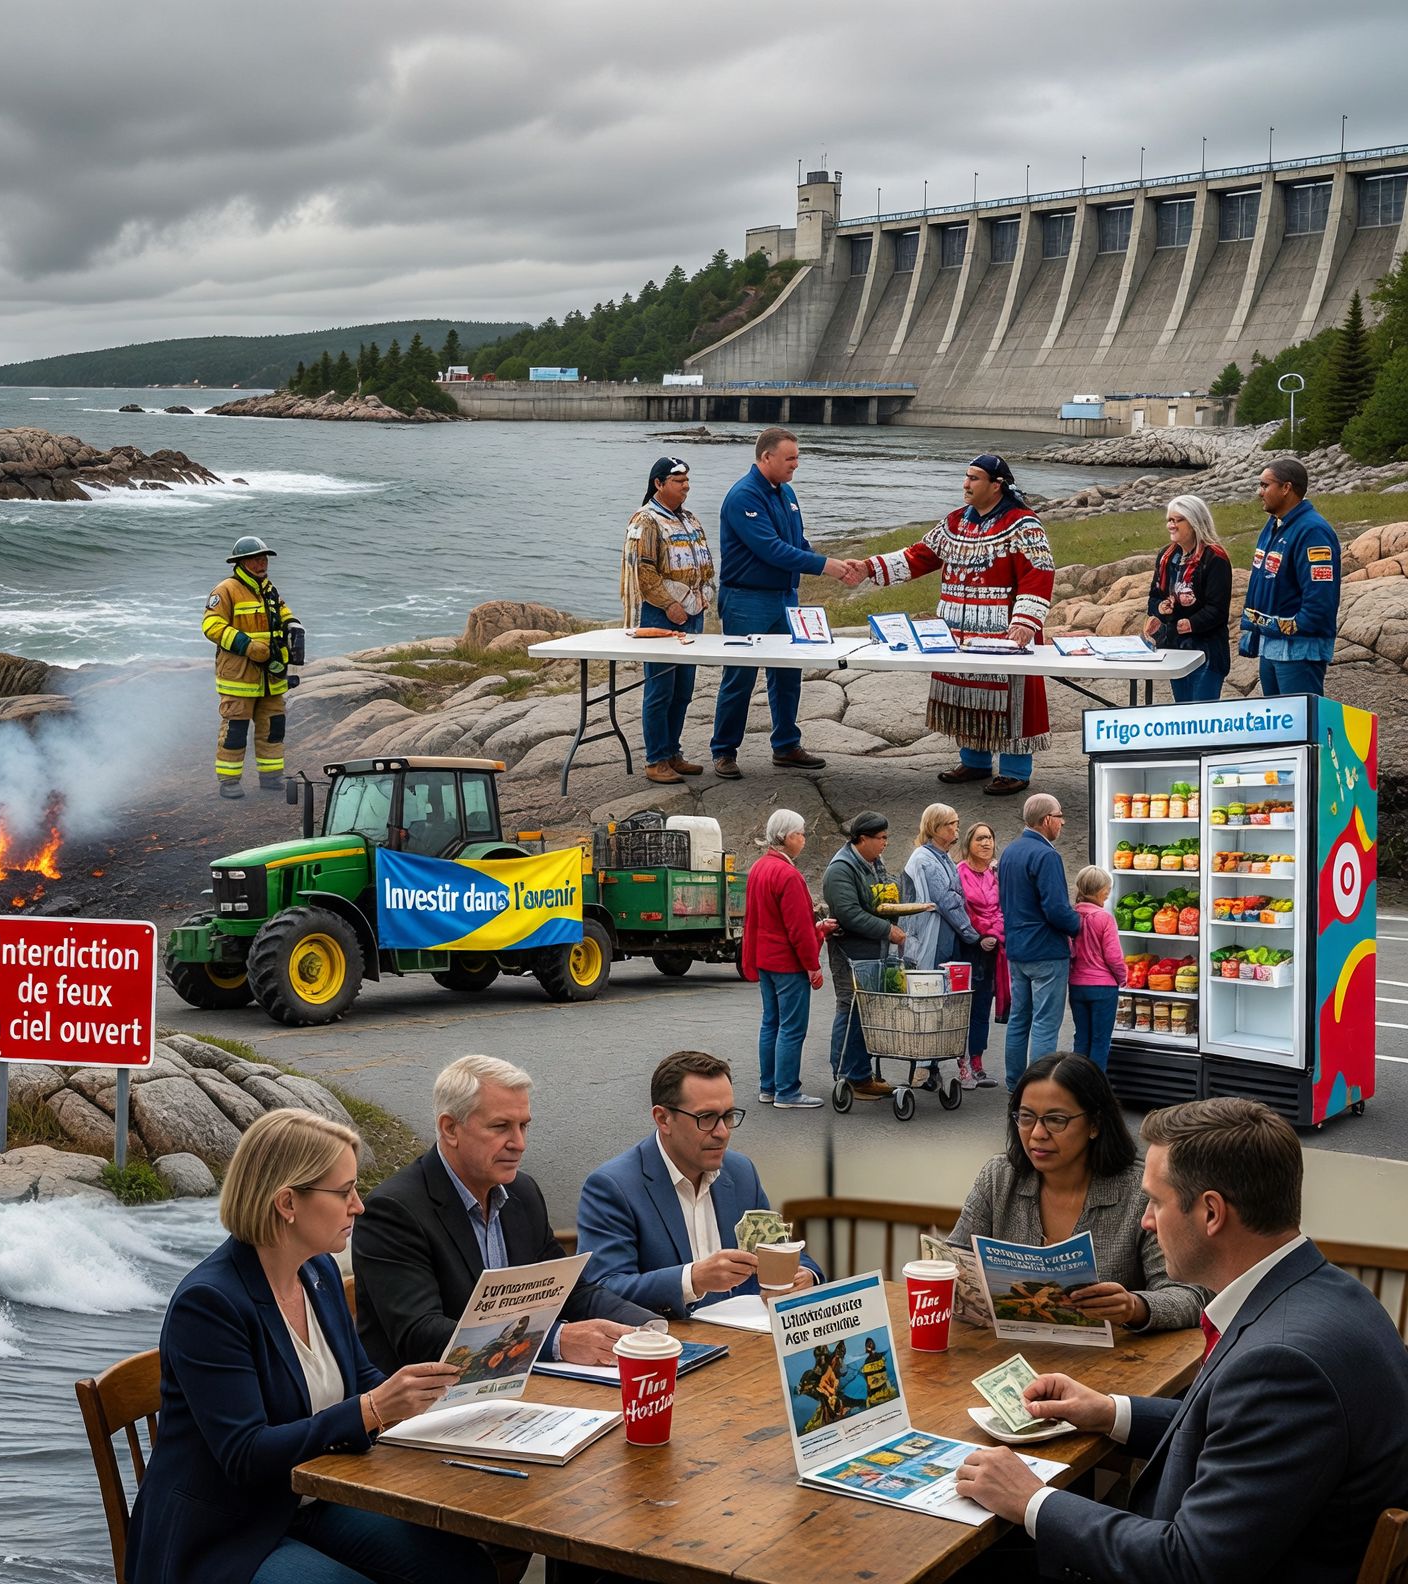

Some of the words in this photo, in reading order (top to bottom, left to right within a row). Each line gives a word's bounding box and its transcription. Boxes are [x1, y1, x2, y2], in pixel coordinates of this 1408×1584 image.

[1096, 720, 1140, 744] Frigo
[1144, 709, 1293, 737] communautaire
[385, 878, 459, 912] Investir
[463, 883, 509, 912] dans
[514, 880, 577, 910] l'avenir
[18, 973, 48, 1004] de
[56, 975, 113, 1007] feux
[9, 1010, 51, 1041] ciel
[59, 1018, 142, 1046] ouvert
